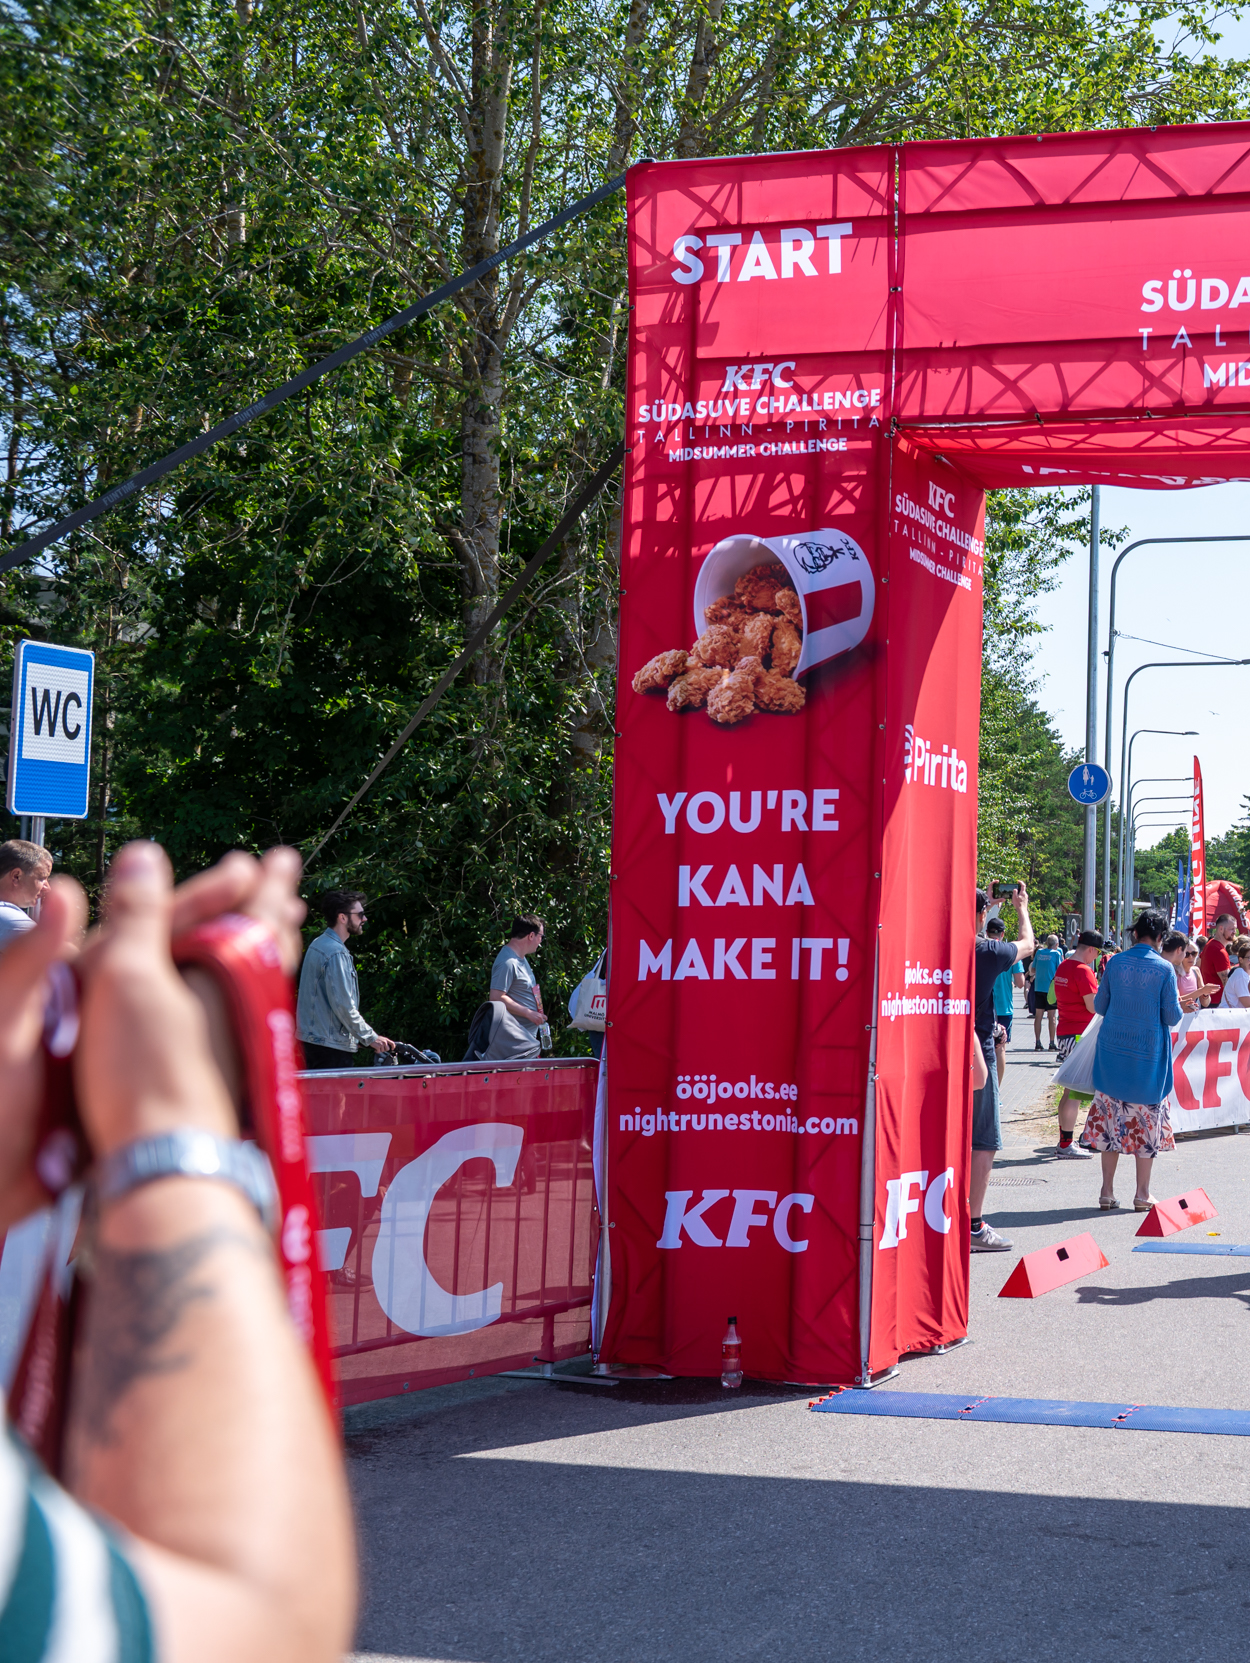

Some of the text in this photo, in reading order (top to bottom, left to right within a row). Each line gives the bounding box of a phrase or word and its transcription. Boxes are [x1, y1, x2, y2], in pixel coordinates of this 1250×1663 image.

[670, 222, 853, 285] START
[721, 361, 796, 393] KFC
[637, 388, 881, 423] SÜDASUVE CHALLENGE
[636, 422, 753, 444] TALLINN
[786, 414, 879, 433] PIRITA
[668, 437, 848, 463] MIDSUMMER CHALLENGE
[928, 480, 955, 518] KFC
[849, 537, 860, 561] KFC
[894, 520, 936, 554] TALLINN
[948, 549, 983, 577] PIRITA
[935, 519, 984, 558] CHALLENGE
[935, 564, 972, 592] CHALLENGE
[31, 687, 82, 740] WC
[914, 736, 967, 793] Pirita
[656, 788, 840, 834] YOU'RE
[678, 863, 815, 907] KANA
[637, 937, 850, 982] MAKE IT!
[676, 1074, 798, 1104] ööjooks.ee
[619, 1106, 858, 1137] nightrunestonia.com
[303, 1122, 524, 1337] FC
[655, 1188, 816, 1254] KFC
